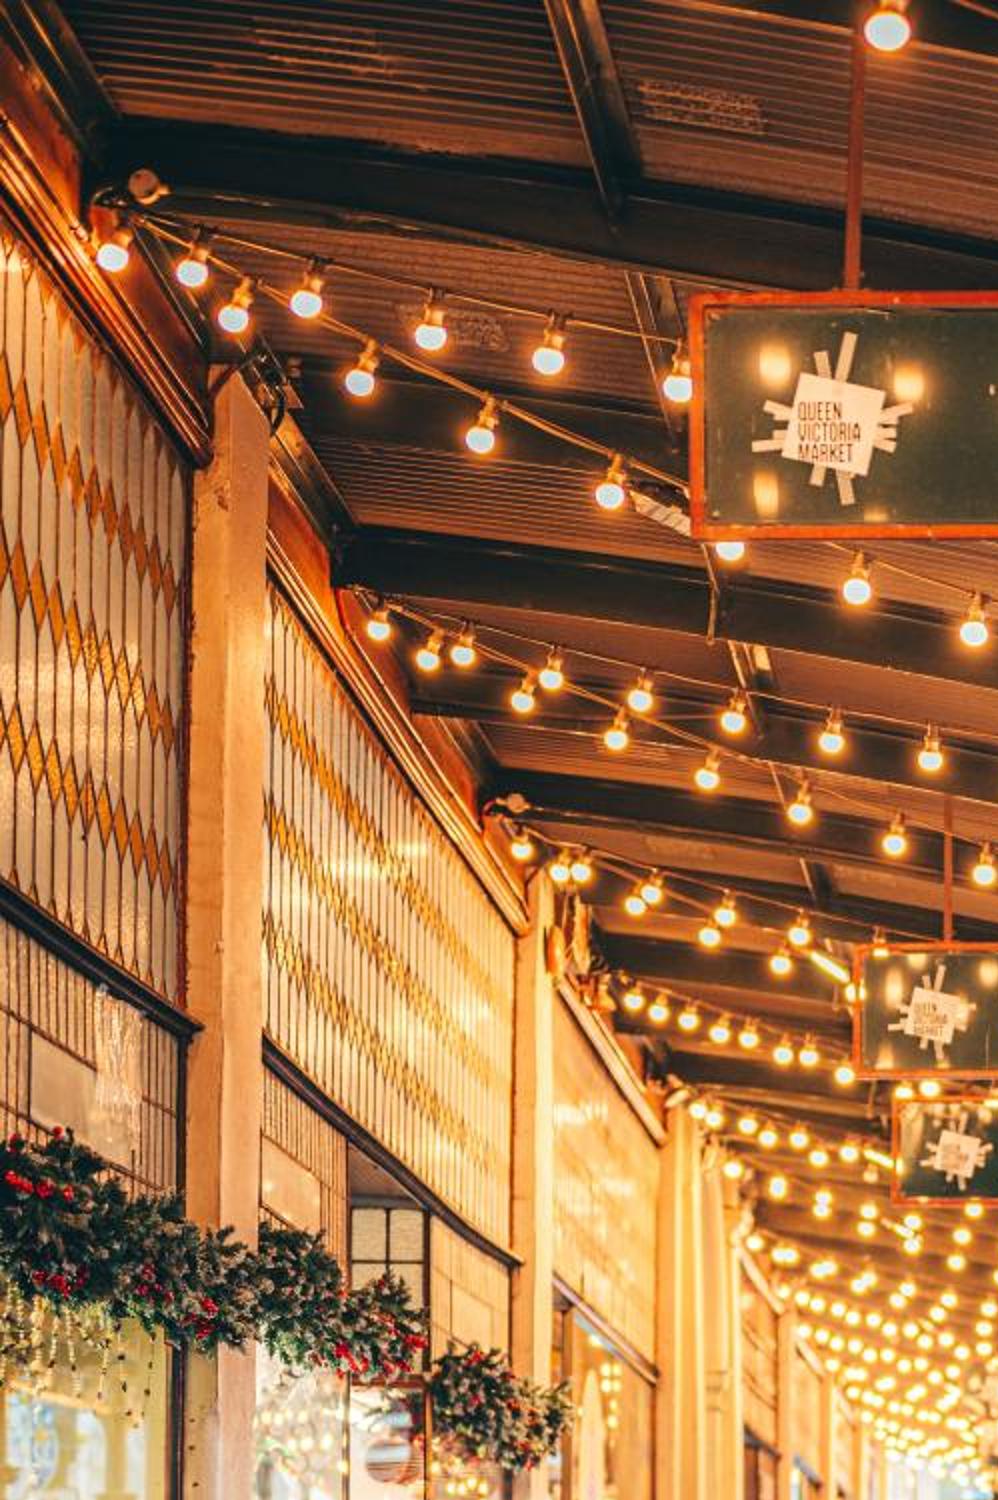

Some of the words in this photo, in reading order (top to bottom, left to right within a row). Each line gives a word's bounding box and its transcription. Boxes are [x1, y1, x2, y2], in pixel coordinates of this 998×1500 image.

[797, 401, 843, 421] QUEEN
[797, 422, 861, 441] VICTORIA
[797, 443, 854, 463] MARKET
